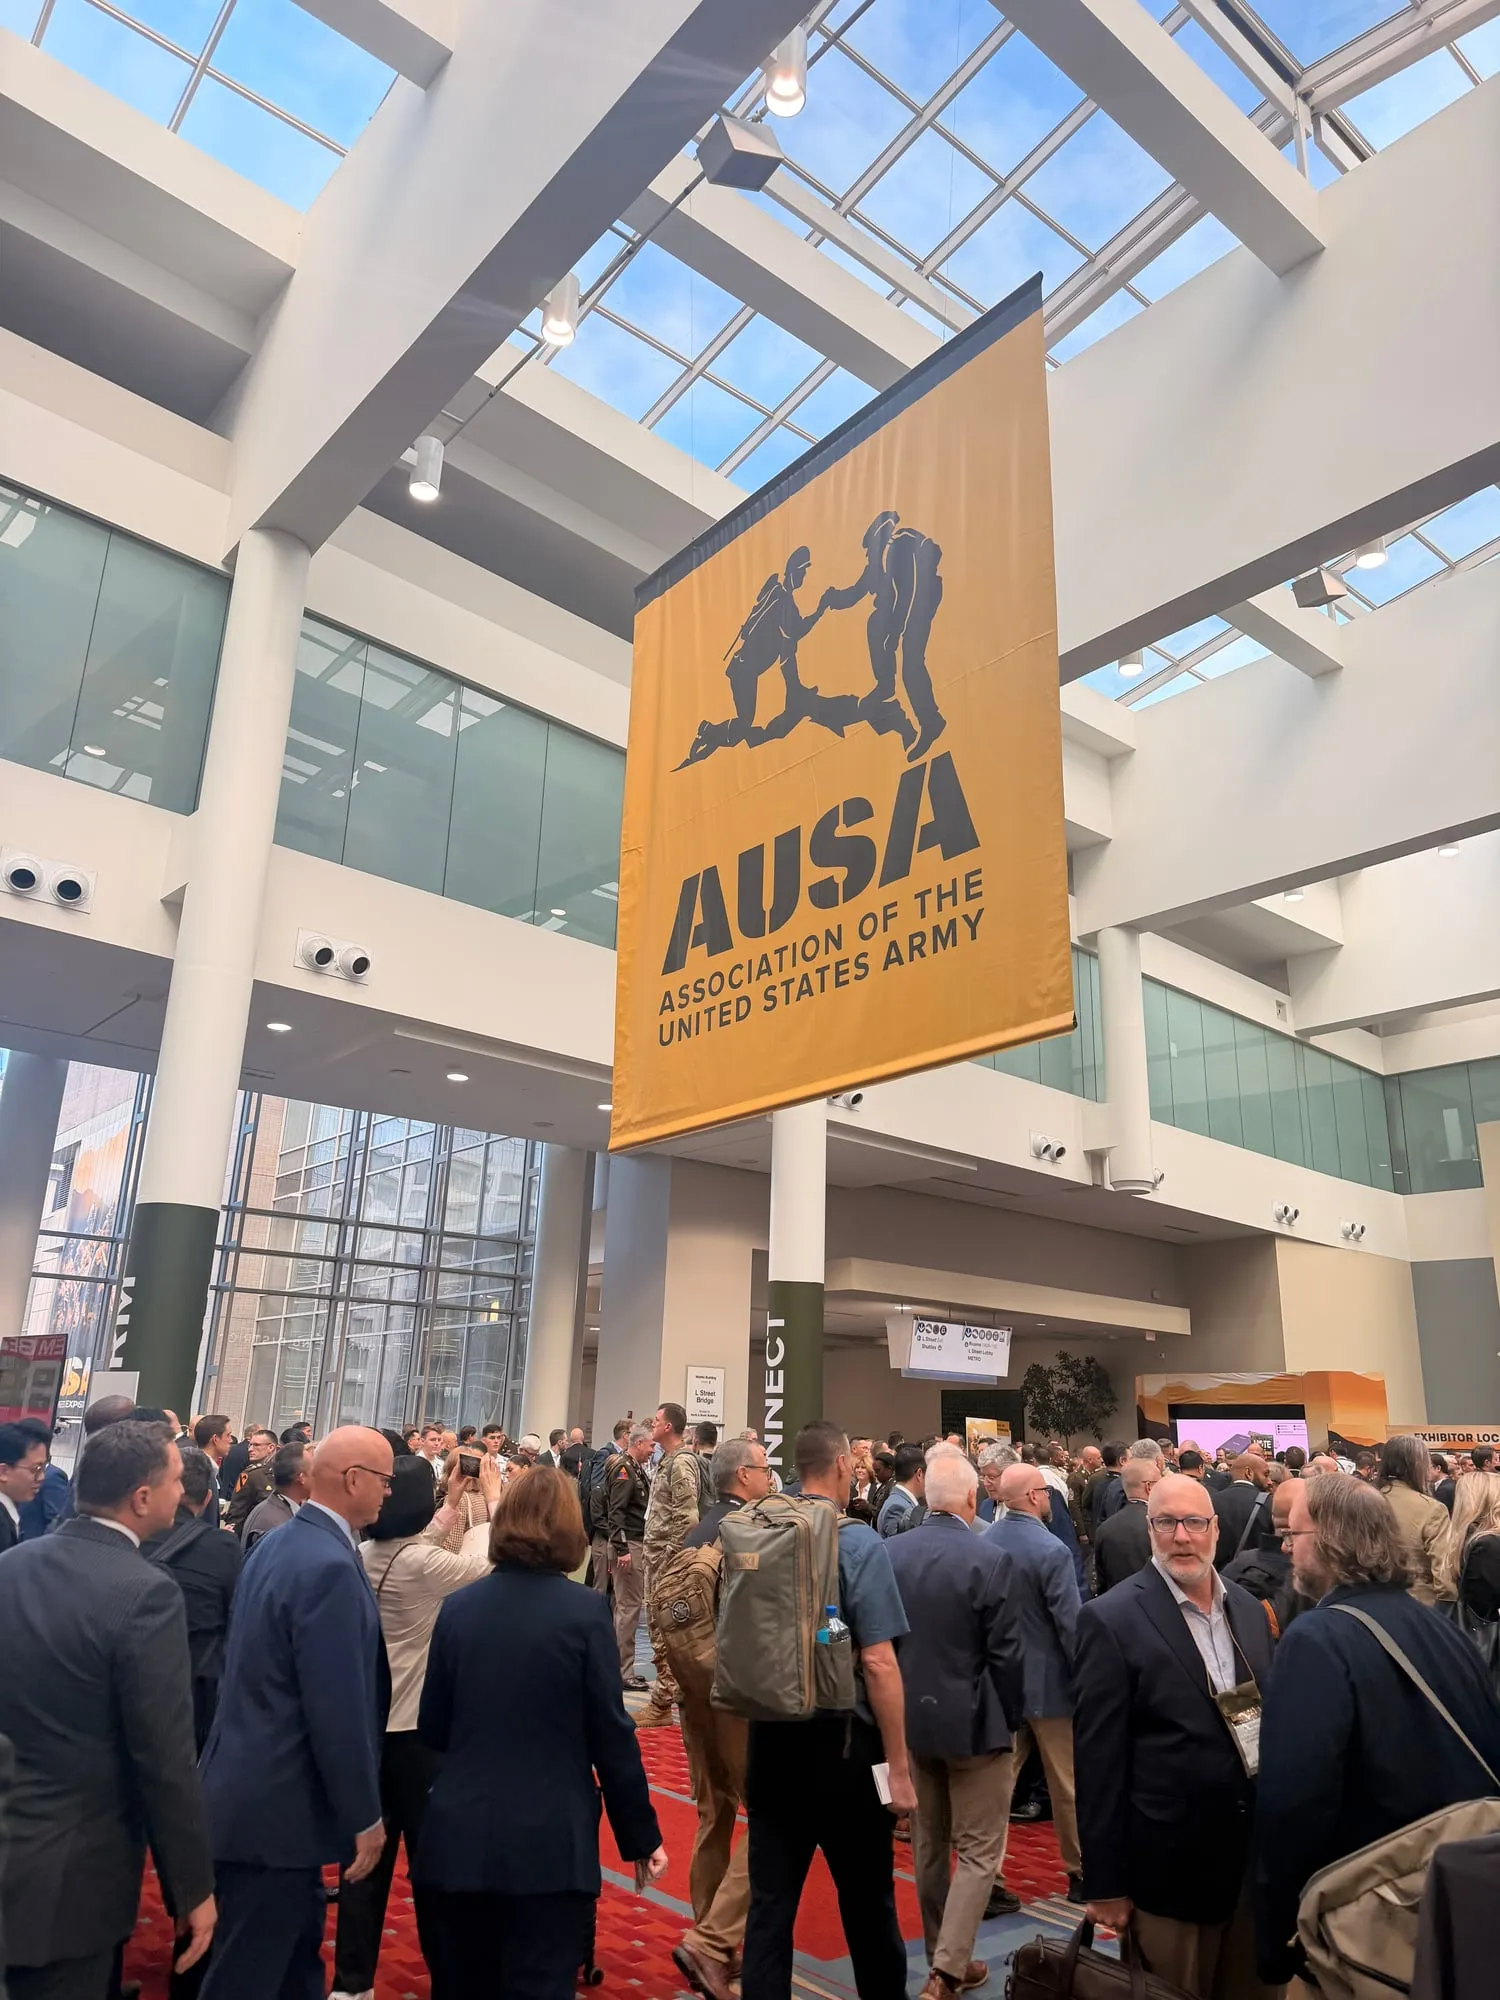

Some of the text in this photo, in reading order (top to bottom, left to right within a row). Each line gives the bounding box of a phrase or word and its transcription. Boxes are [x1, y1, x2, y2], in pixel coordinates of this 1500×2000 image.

[661, 751, 981, 975] AUSA
[658, 908, 986, 1047] UNITED STATES ARMY
[659, 867, 984, 1016] ASSOCIATION OF THE
[697, 1397, 714, 1405] Bridge
[1414, 1433, 1473, 1442] EXHIBITOR
